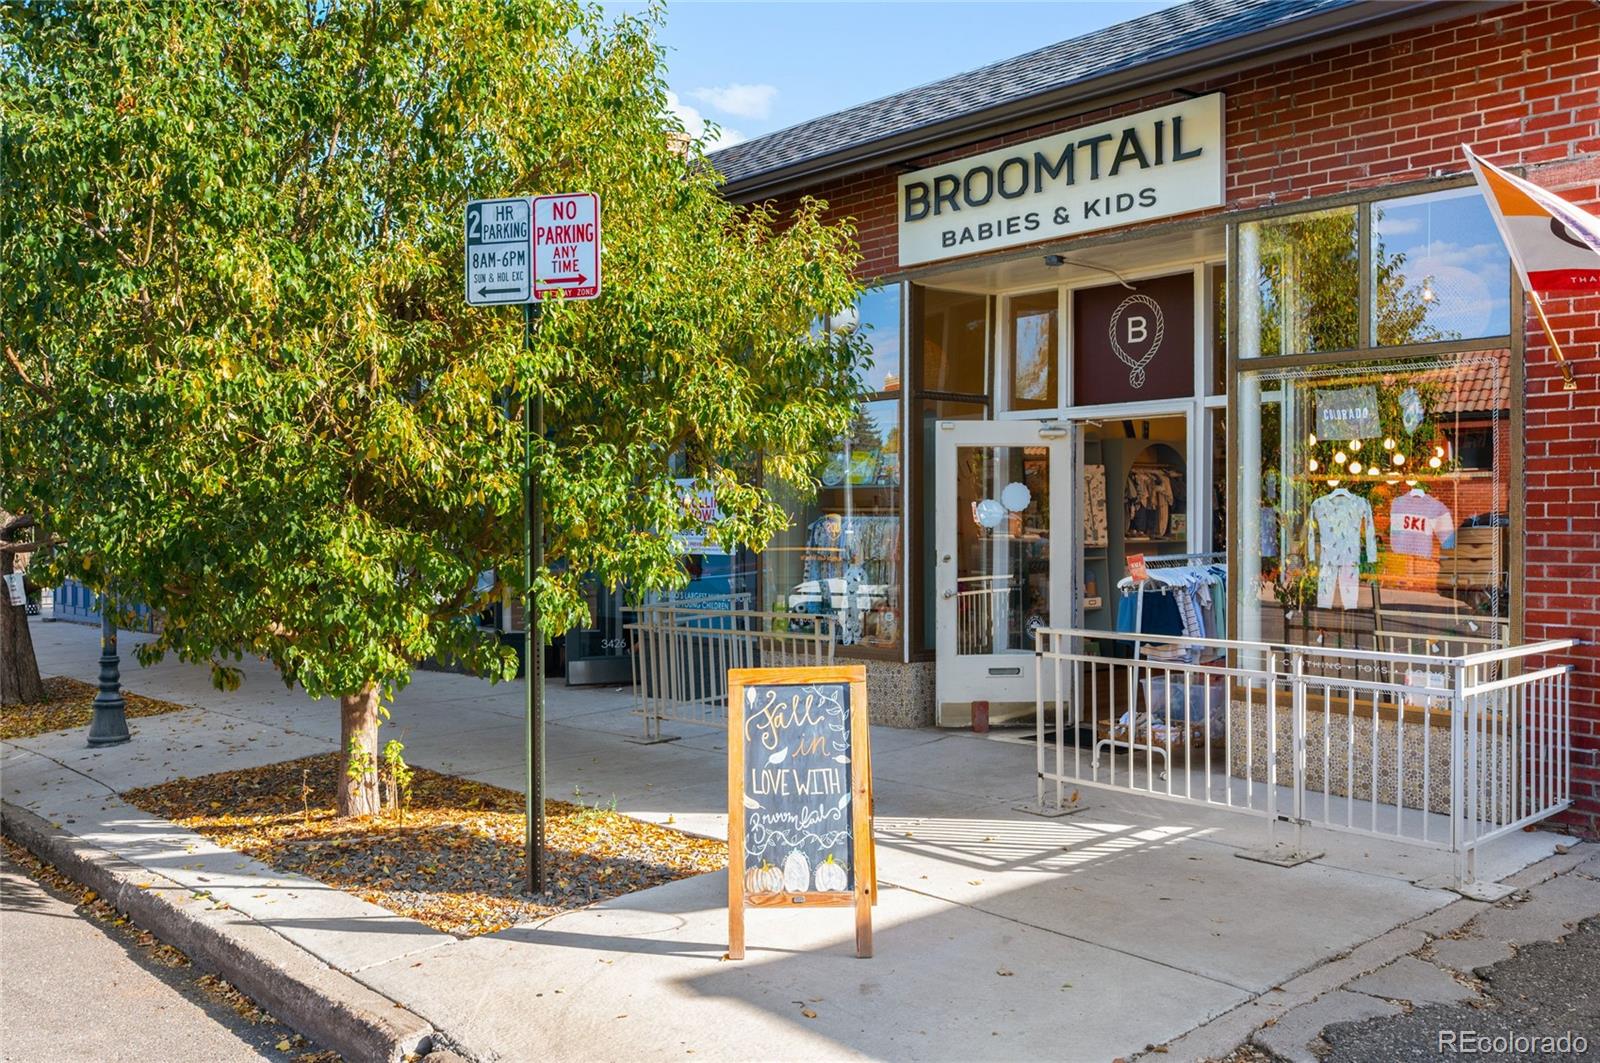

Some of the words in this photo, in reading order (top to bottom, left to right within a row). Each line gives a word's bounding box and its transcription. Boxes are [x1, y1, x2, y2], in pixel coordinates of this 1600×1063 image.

[904, 115, 1203, 223] BROOMTAIL
[496, 205, 514, 222] HR
[553, 200, 577, 221] NO
[941, 212, 1040, 248] BABIES
[1053, 206, 1070, 225] &
[1083, 187, 1158, 219] KIDS
[468, 210, 481, 239] 2
[483, 222, 527, 241] PARKING
[536, 223, 594, 246] PARKING
[472, 250, 526, 269] 8AM-6PM
[553, 245, 578, 260] ANY
[552, 259, 580, 274] TIME
[473, 273, 487, 284] SUN
[488, 273, 495, 283] &
[497, 272, 509, 282] HOL
[512, 270, 524, 281] EXC
[1570, 275, 1600, 284] THA
[577, 287, 594, 297] ZONE
[1127, 315, 1148, 343] B
[1323, 406, 1369, 420] COLORADO
[1403, 515, 1426, 531] SKI
[600, 638, 627, 649] 3426
[1282, 658, 1342, 670] CTHING
[791, 732, 831, 758] in
[752, 767, 790, 796] LOVE
[792, 767, 841, 796] WITH
